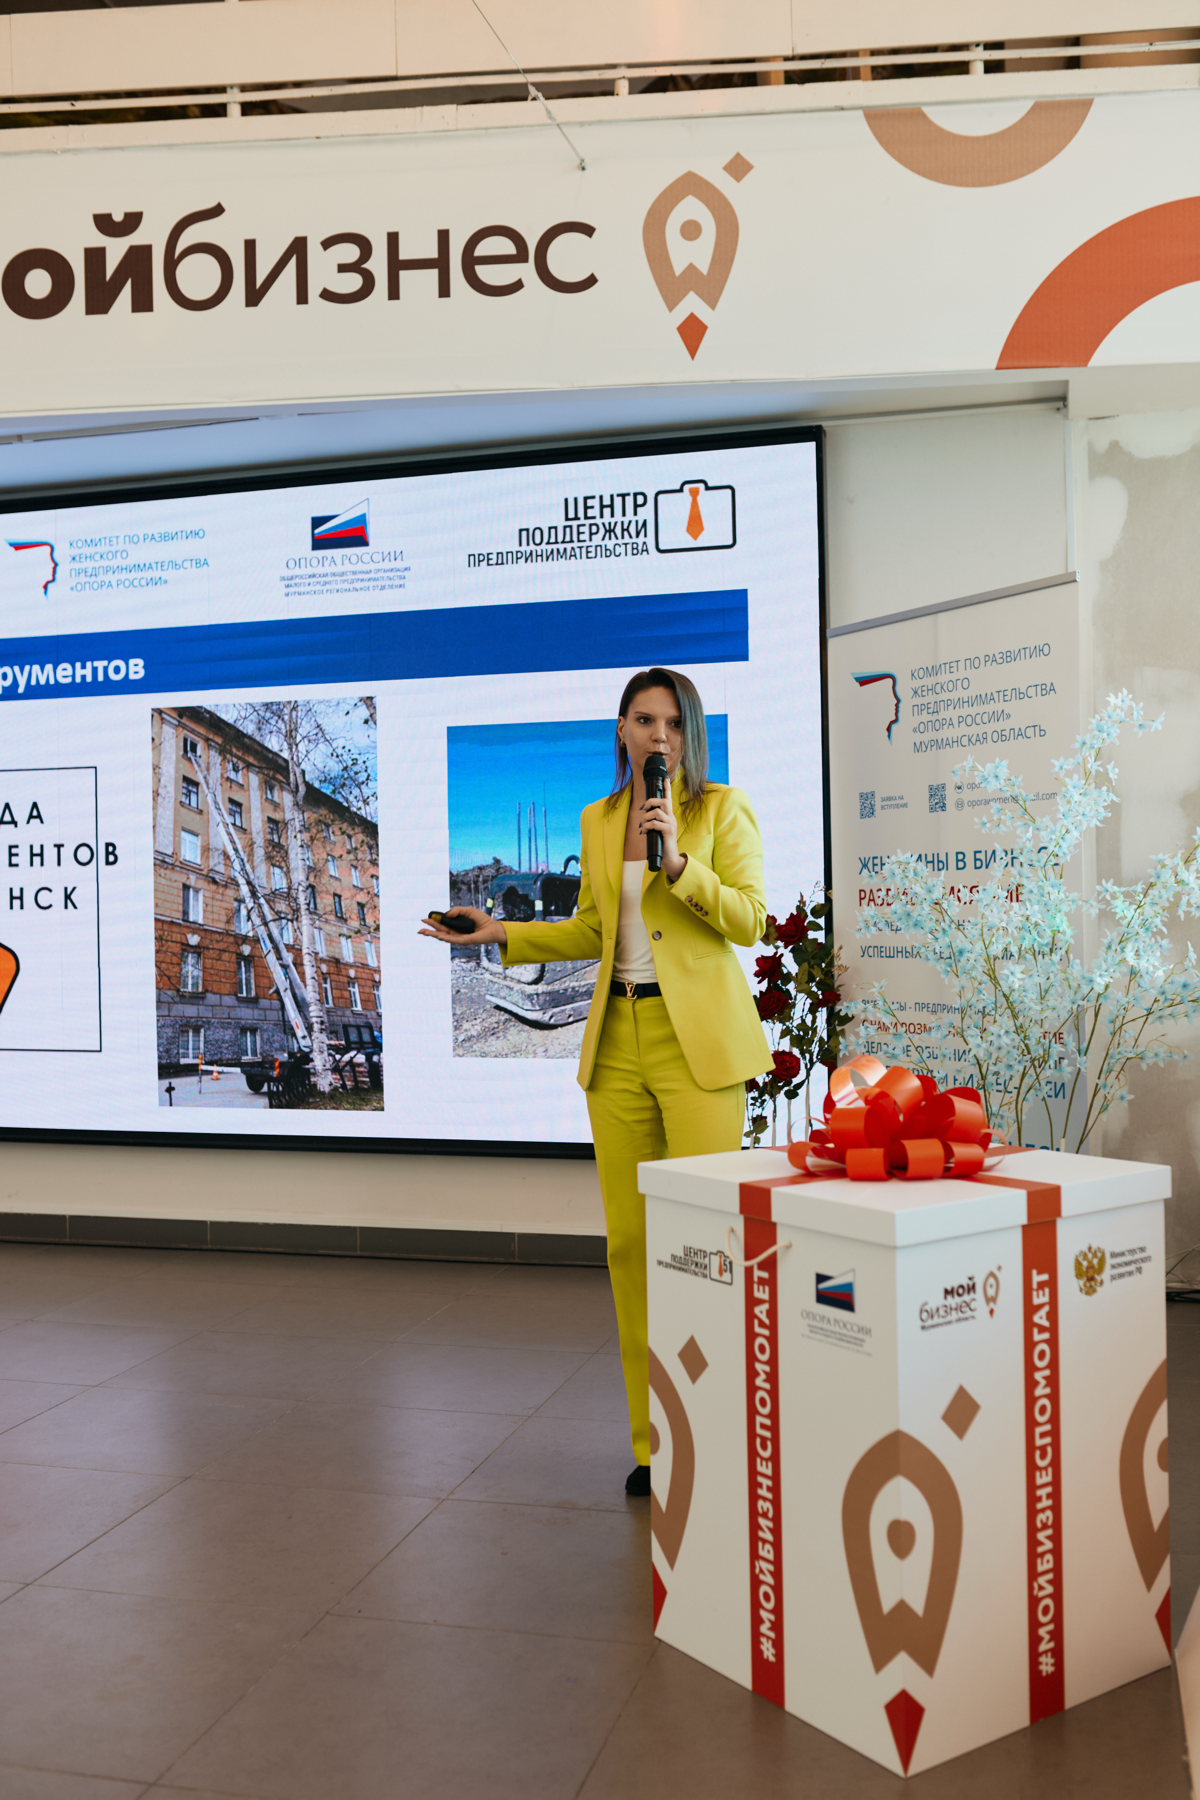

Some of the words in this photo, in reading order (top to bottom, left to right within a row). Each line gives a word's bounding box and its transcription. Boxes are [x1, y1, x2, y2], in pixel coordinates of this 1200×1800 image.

[563, 491, 648, 521] ЦЕНТР
[69, 536, 120, 550] КОМИТЕТ
[124, 534, 140, 546] ПО
[143, 528, 206, 543] РАЗВИТИЮ
[518, 519, 648, 547] ПОДДЕРЖКИ
[69, 550, 129, 564] ЖЕНСКОГО
[286, 555, 338, 570] ОПОРА
[342, 550, 404, 566] РОССИИ
[467, 541, 650, 567] ПРЕДПРИНИМАТЕЛЬСТВА
[69, 558, 210, 578] ПРЕДПРИНИМАТЕЛЬСТВА
[69, 580, 114, 592] «ОПОРА
[116, 576, 168, 589] РОССИИ»
[910, 660, 961, 681] КОМИТЕТ
[964, 656, 981, 672] ПО
[984, 642, 1052, 667] РАЗВИТИЮ
[0, 658, 145, 694] рументов
[910, 677, 970, 700] ЖЕНСКОГО
[912, 682, 1057, 717] ПРЕДПРИНИМАТЕЛЬСТВА
[912, 716, 955, 734] «ОПОРА
[957, 709, 1012, 730] РОССИИ»
[913, 732, 988, 754] МУРМАНСКАЯ
[990, 724, 1047, 744] ОБЛАСТЬ
[880, 802, 909, 810] ВСТУПЛЕНИЕ
[8, 842, 119, 867] ЕНТОВ
[955, 851, 967, 871] В
[9, 886, 78, 910] НСК
[670, 1253, 708, 1271] ПОДДЕРЖКИ
[683, 1244, 708, 1262] ЦЕНТР
[723, 1258, 733, 1275] 51
[800, 1309, 832, 1327] ОПОРА
[833, 1317, 873, 1338] РОССИИ
[753, 1263, 777, 1664] #МОЙБИЗНЕСПОМОГАЕТ
[1031, 1269, 1056, 1677] #МОЙБИЗНЕСПОМОГАЕТ
